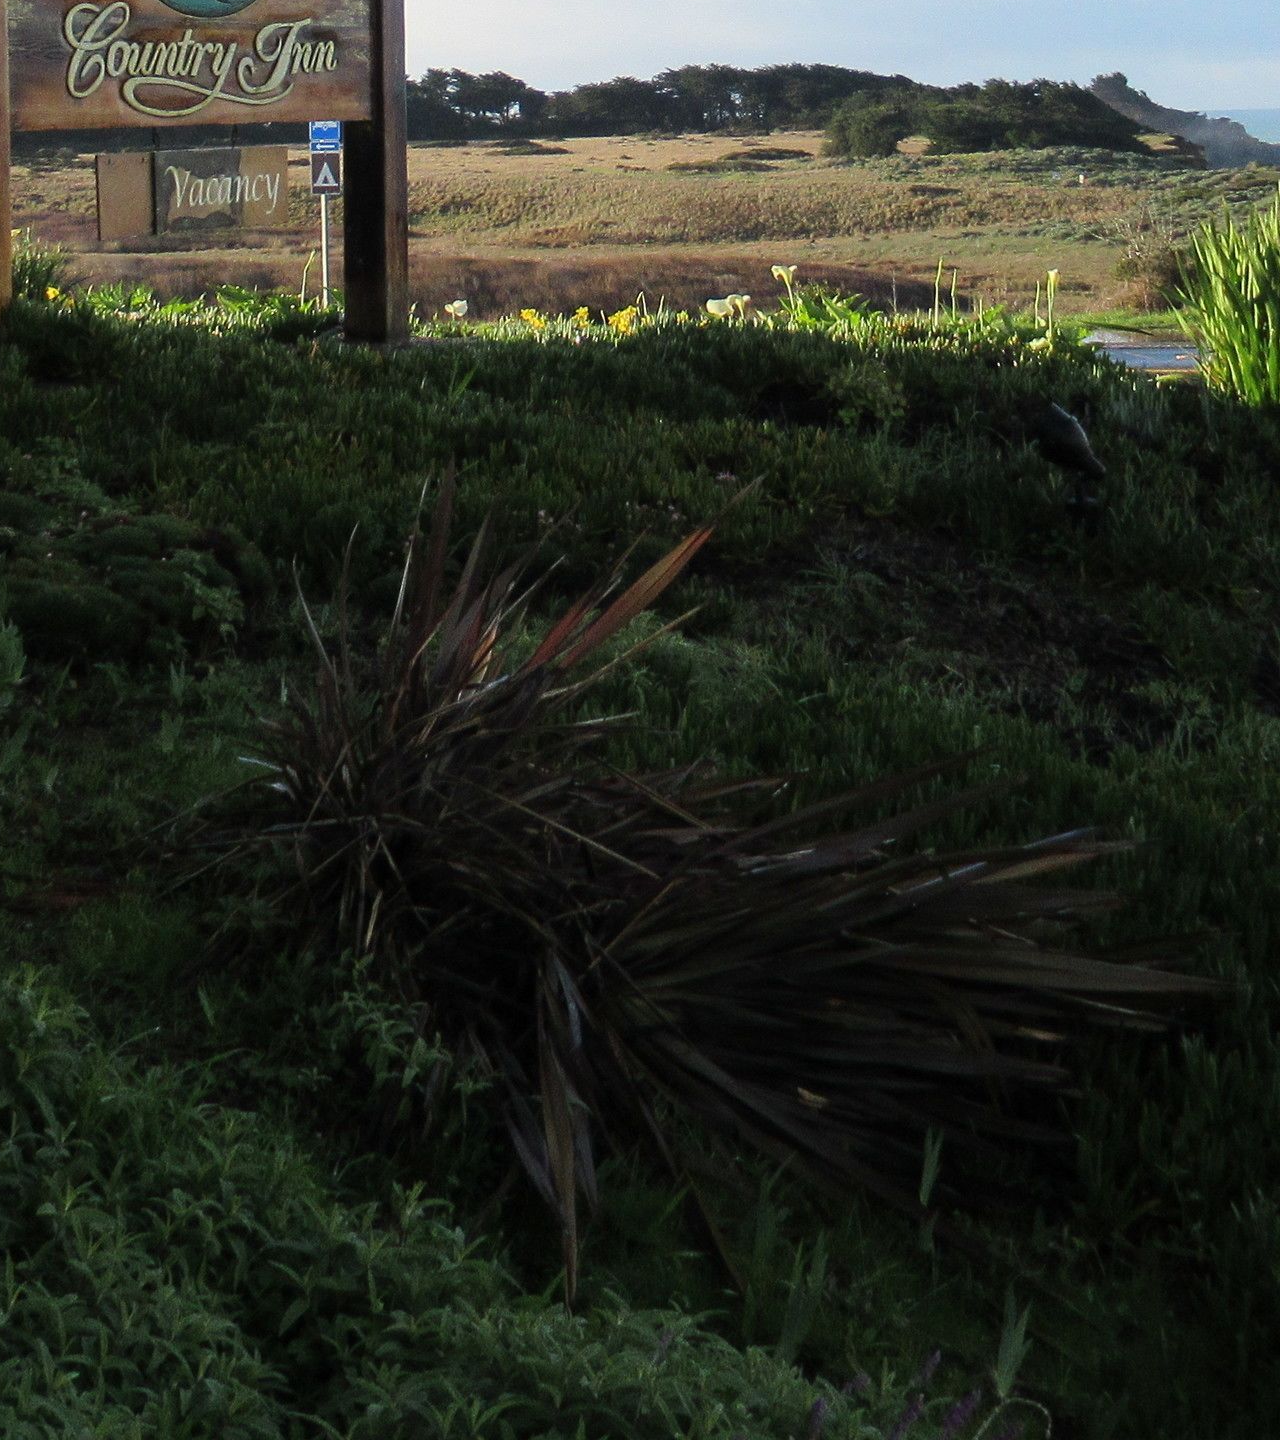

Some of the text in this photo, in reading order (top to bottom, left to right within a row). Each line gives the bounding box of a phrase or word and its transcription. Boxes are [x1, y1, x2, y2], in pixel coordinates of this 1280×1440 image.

[65, 1, 338, 117] Country Inn
[164, 165, 281, 215] Vacancy
